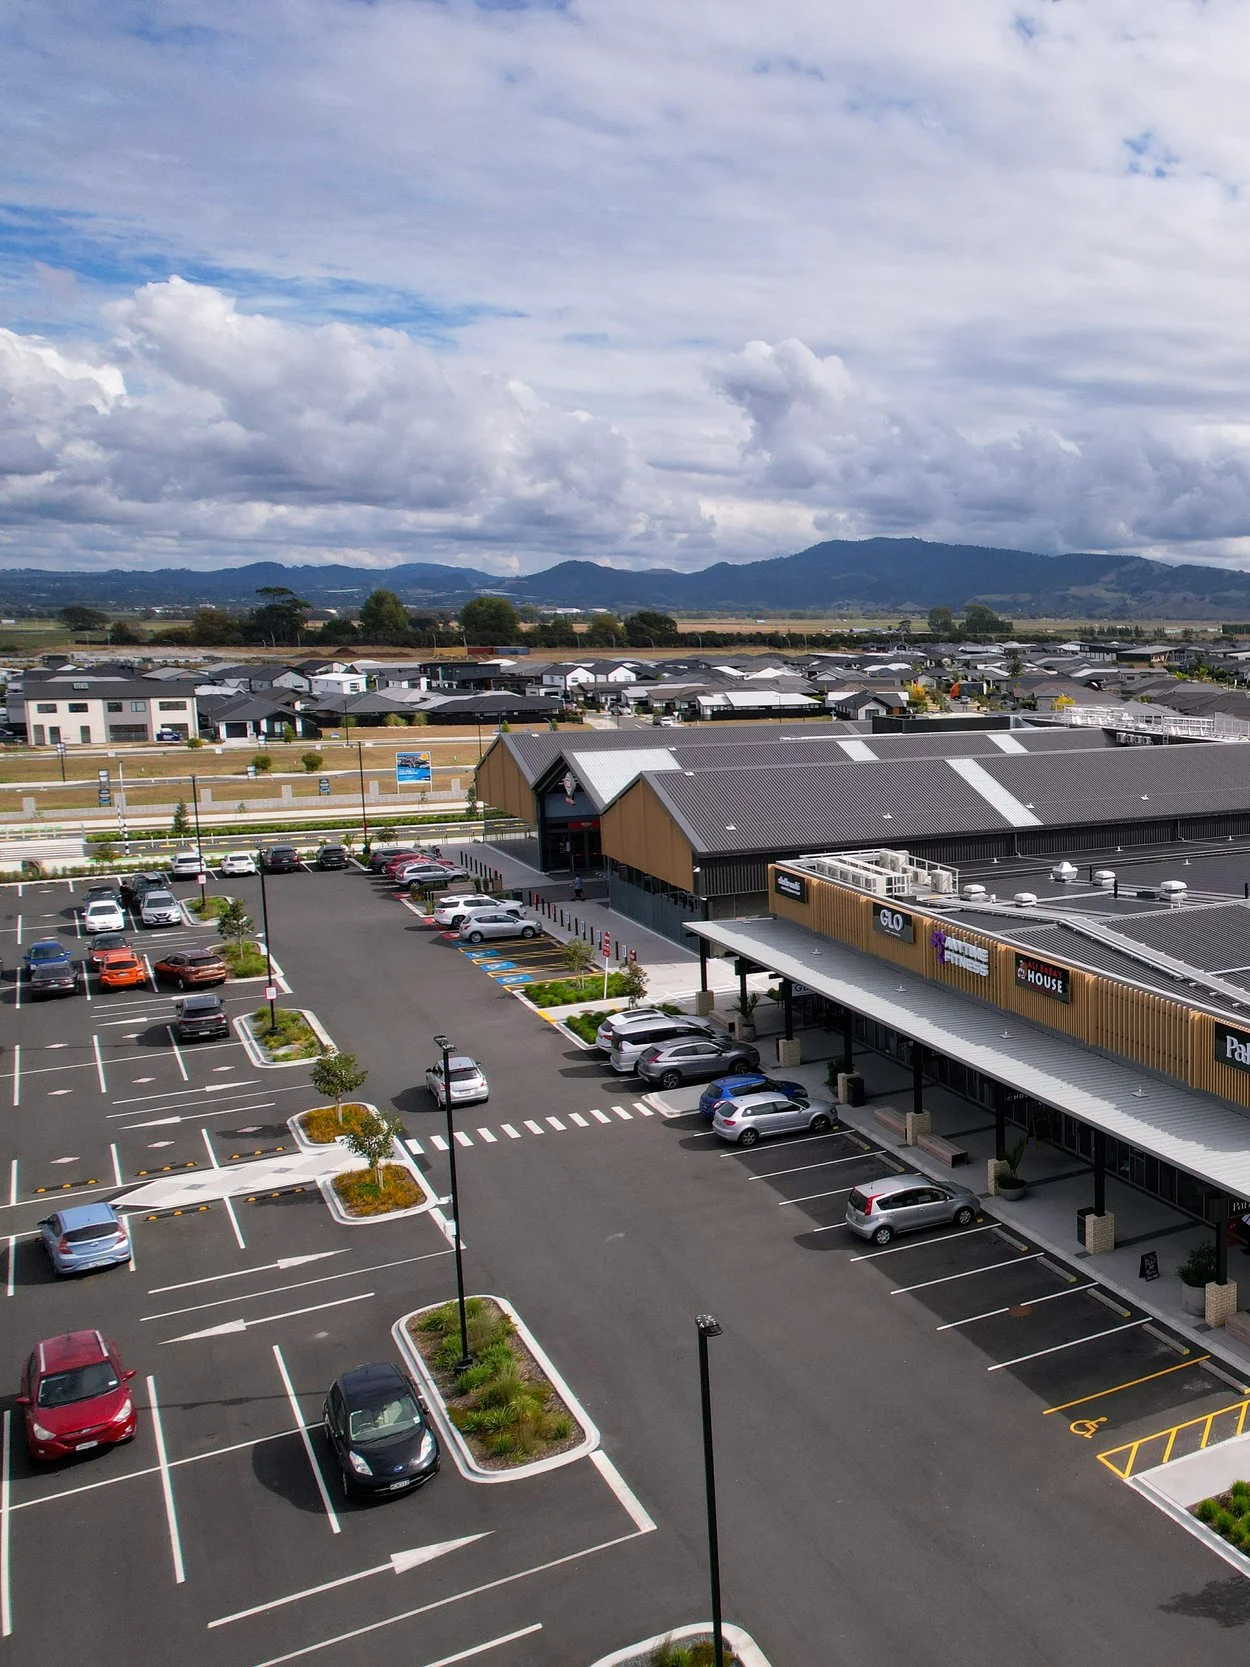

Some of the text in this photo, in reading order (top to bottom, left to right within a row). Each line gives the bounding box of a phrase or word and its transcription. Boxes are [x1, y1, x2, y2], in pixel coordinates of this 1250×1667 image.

[880, 908, 904, 931] GLO
[945, 936, 989, 962] ANYTIME
[944, 950, 989, 977] FITNESS
[1027, 968, 1063, 994] HOUSE
